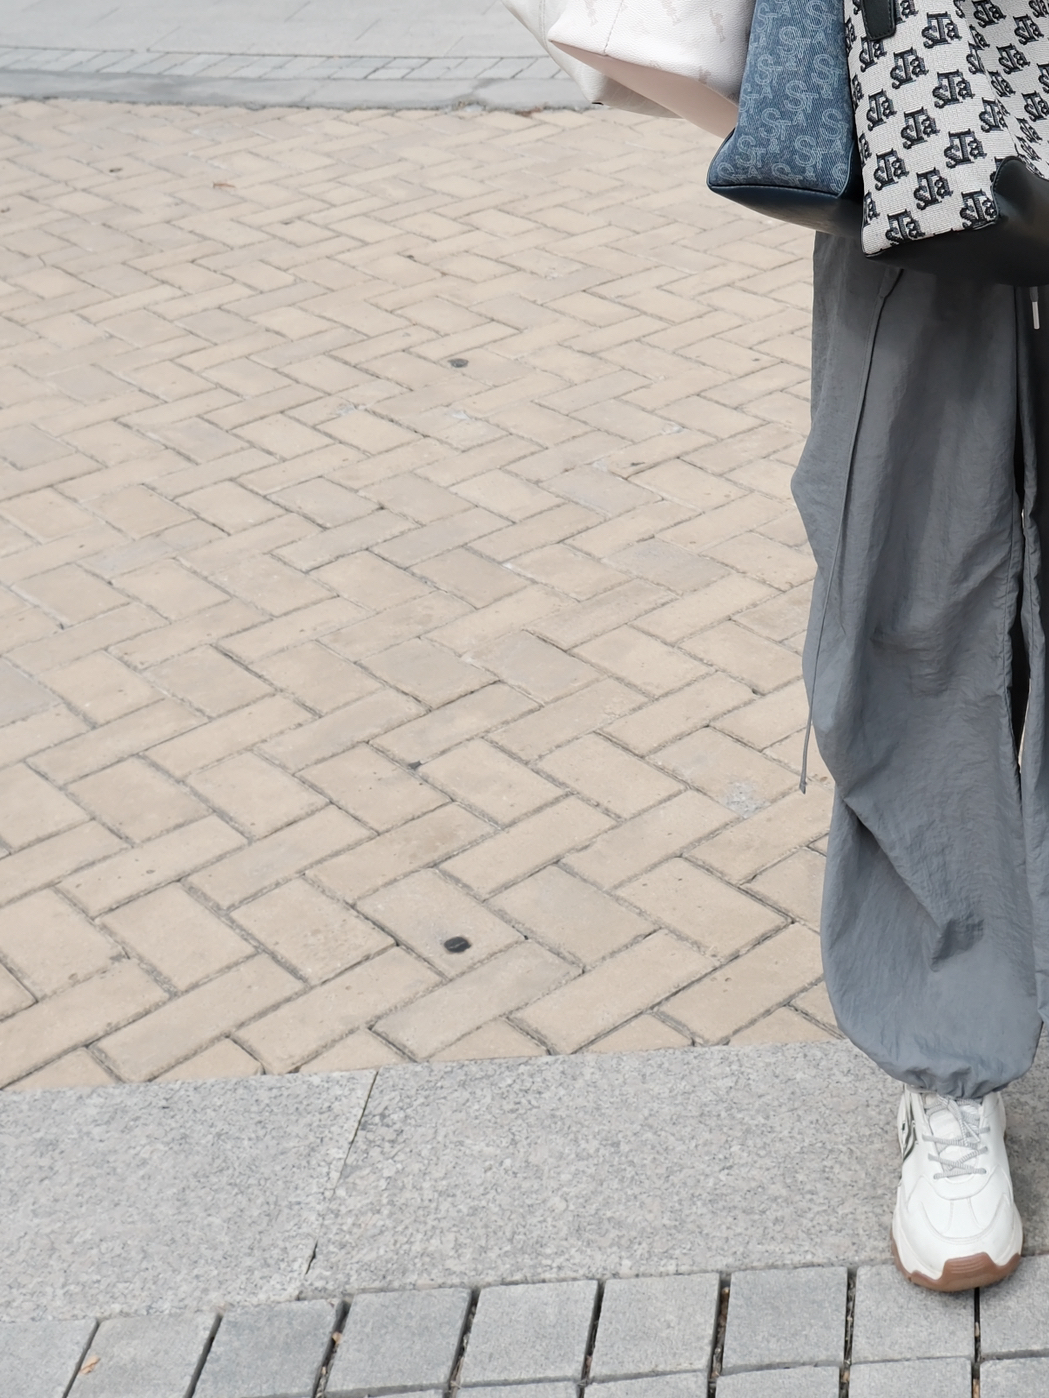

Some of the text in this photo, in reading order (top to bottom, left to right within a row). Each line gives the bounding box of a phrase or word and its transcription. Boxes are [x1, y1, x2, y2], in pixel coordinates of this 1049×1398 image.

[921, 11, 962, 49] sTa
[1013, 13, 1045, 45] sTa
[890, 46, 929, 90] sTa
[996, 42, 1031, 75] sTa
[932, 68, 976, 109] sTa
[866, 88, 898, 132] sTa
[900, 106, 941, 150] sTa
[943, 128, 988, 169] sTa
[873, 148, 910, 191] sTa
[913, 166, 954, 210] sTa
[959, 188, 998, 229] sTa
